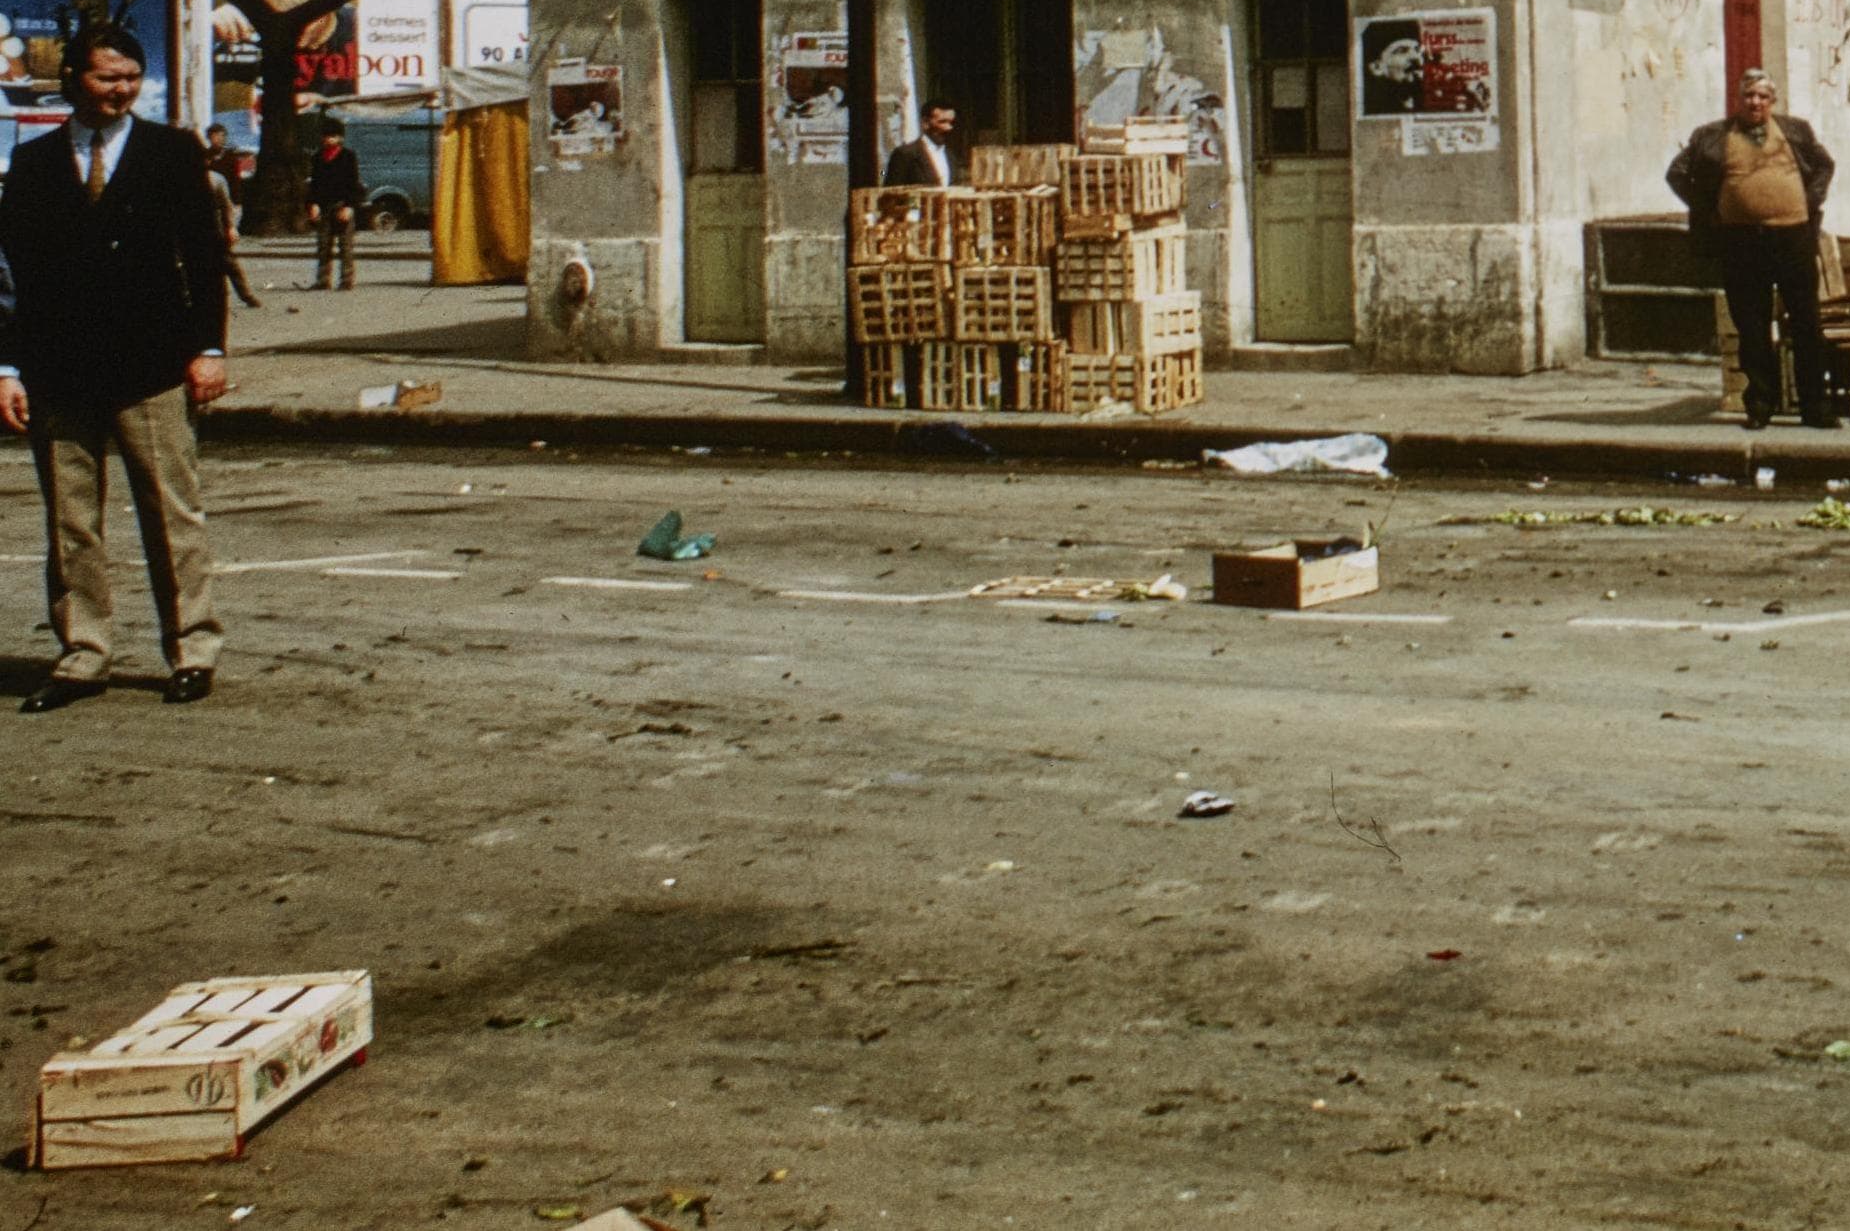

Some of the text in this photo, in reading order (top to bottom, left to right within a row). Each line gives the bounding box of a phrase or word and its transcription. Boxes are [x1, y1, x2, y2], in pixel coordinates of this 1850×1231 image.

[367, 31, 427, 43] dessert
[481, 47, 503, 62] 90
[294, 41, 424, 86] yabon
